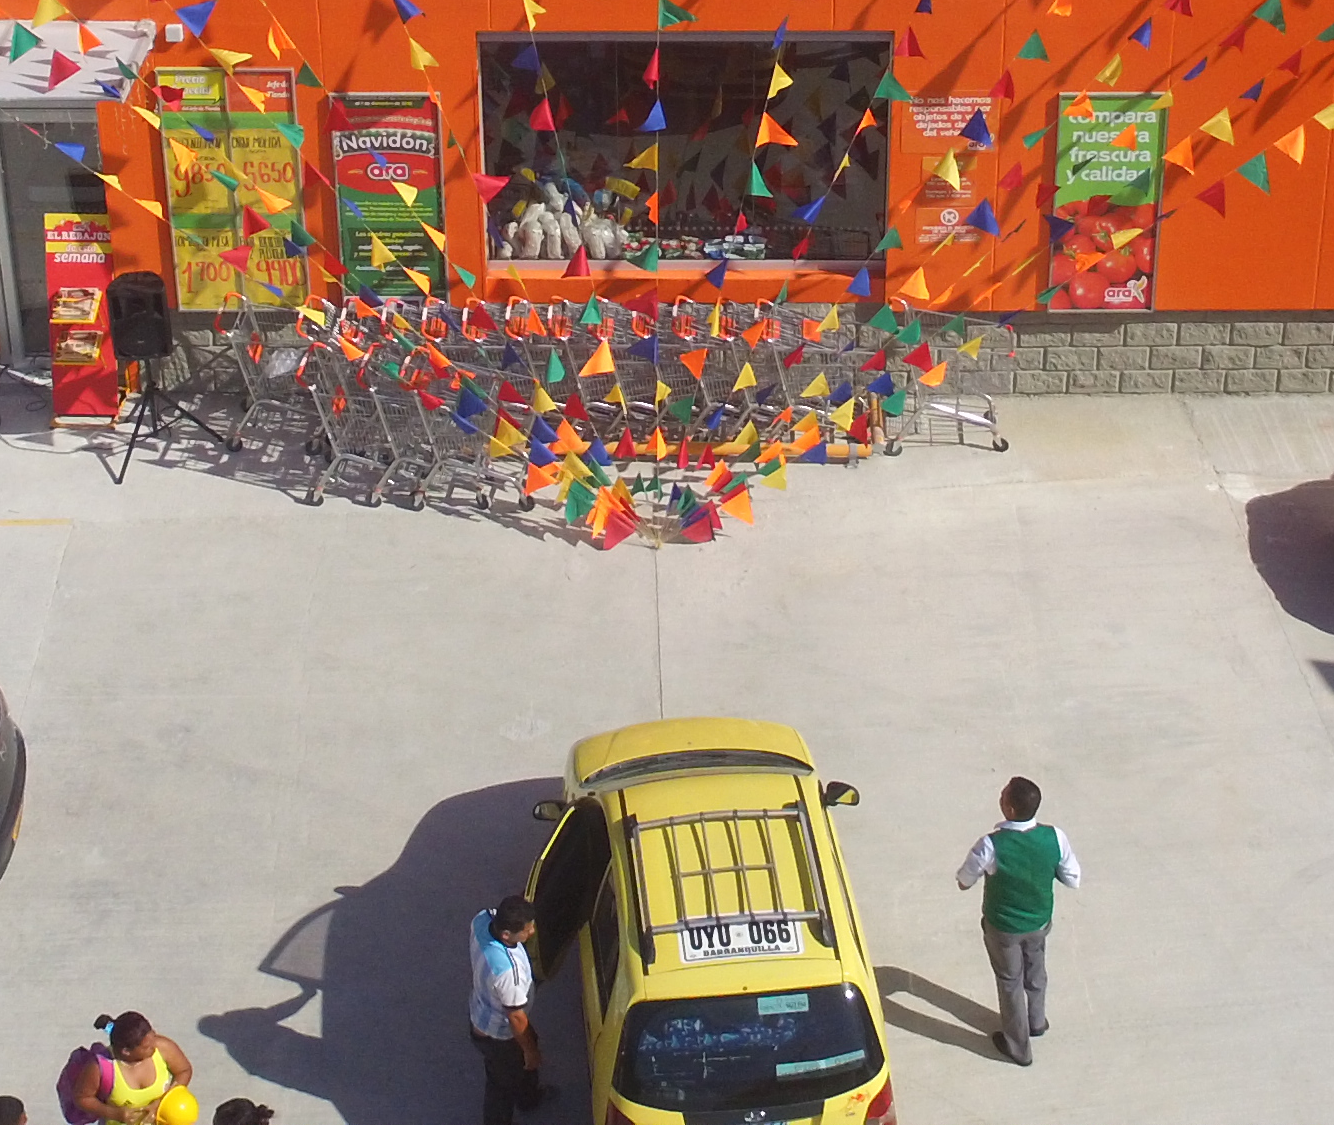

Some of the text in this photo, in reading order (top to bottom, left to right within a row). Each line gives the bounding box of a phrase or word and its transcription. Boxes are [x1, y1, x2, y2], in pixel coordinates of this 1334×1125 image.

[948, 96, 992, 104] hacemos
[909, 105, 972, 113] responsables
[913, 113, 948, 121] objetos
[915, 121, 952, 132] dejados
[341, 131, 428, 151] Navidón
[1069, 147, 1151, 162] frescura
[369, 165, 408, 178] ara
[1081, 166, 1151, 182] calida
[54, 253, 106, 263] semana
[1107, 289, 1132, 298] ara
[687, 919, 791, 951] UYU 066
